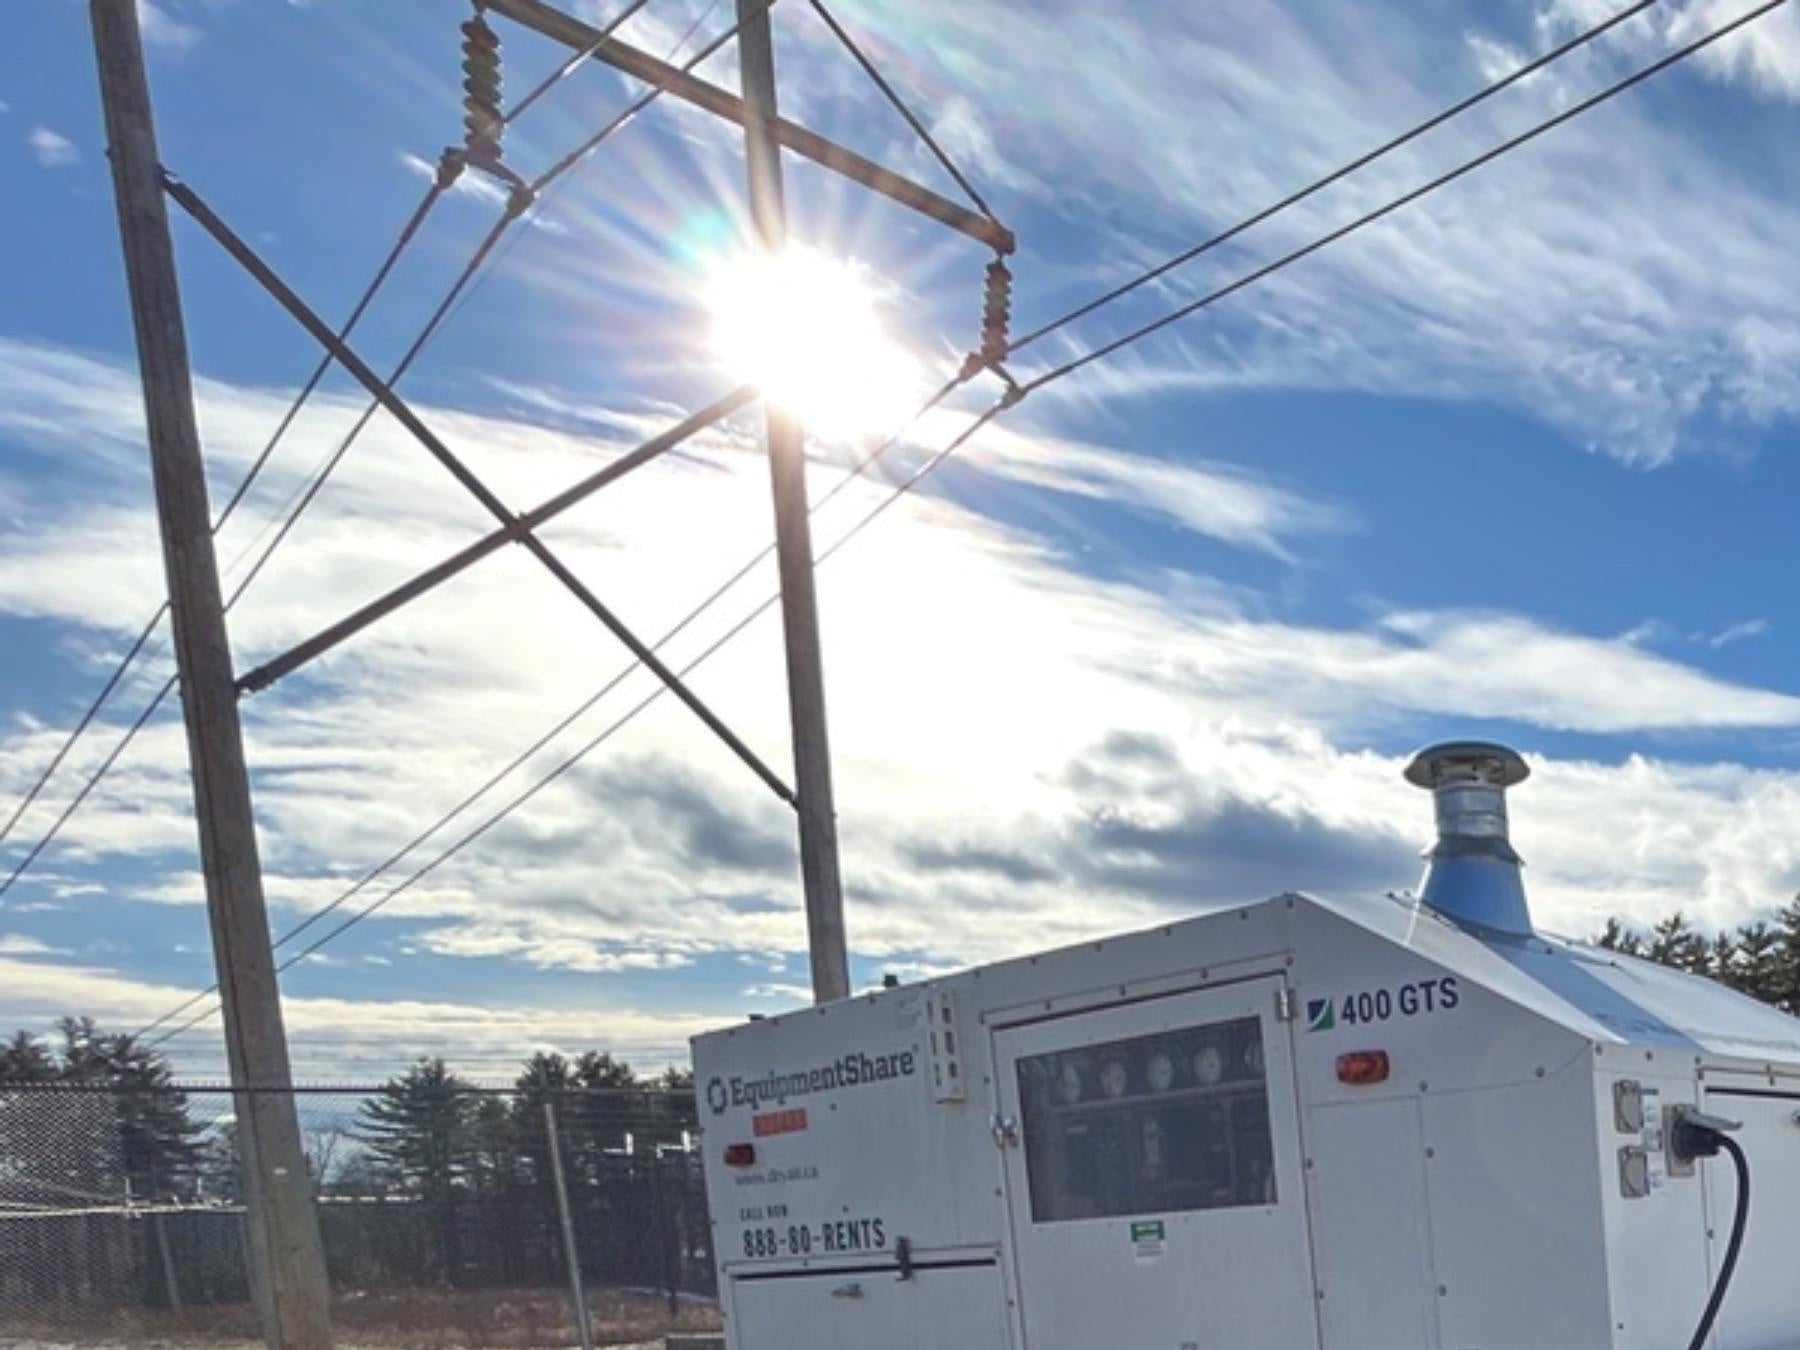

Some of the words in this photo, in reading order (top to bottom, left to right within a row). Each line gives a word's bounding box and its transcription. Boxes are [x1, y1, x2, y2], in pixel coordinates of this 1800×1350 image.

[1341, 989, 1391, 1026] 400
[1399, 976, 1459, 1015] GTS
[729, 1051, 915, 1110] EquipmentShare
[743, 1218, 885, 1257] 888-80-RENTS
